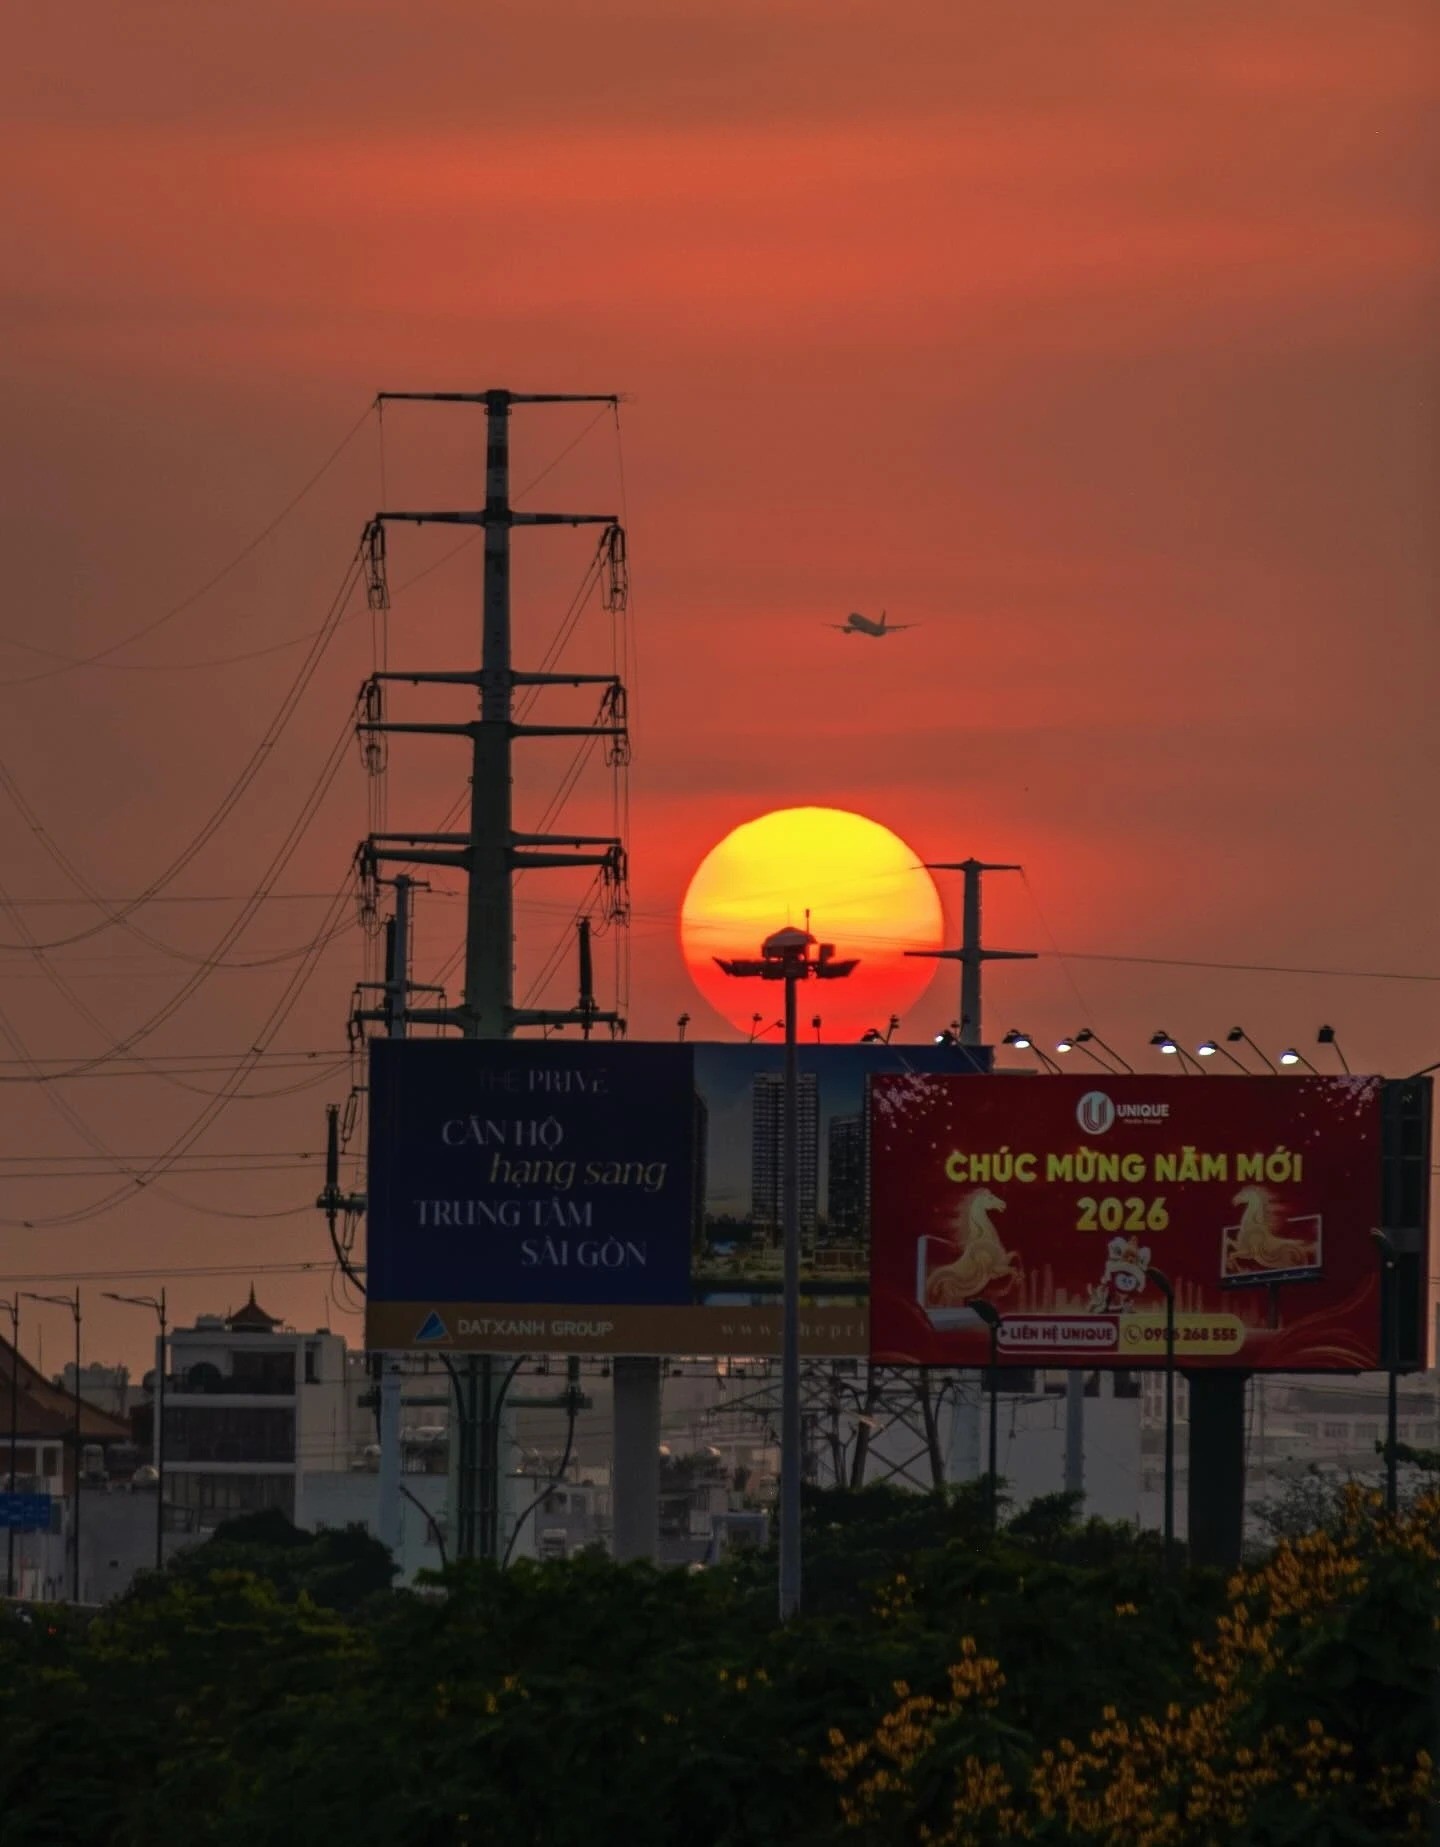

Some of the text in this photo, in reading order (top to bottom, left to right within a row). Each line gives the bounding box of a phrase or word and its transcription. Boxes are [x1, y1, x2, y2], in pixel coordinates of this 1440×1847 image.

[1116, 1103, 1170, 1118] UNIQUE
[514, 1113, 564, 1151] HỘ
[488, 1152, 668, 1192] hạng sang
[944, 1146, 1303, 1183] CHÚC MỪNG NĂM MỚI
[414, 1196, 593, 1227] TRUNG TÂM
[1076, 1196, 1169, 1231] 2026
[520, 1234, 648, 1268] SÀI GÒN
[551, 1319, 614, 1337] GROUP
[1009, 1323, 1114, 1344] LIÊN HỆ UNIQUE
[1183, 1327, 1209, 1342] 268
[1212, 1327, 1238, 1342] 555
